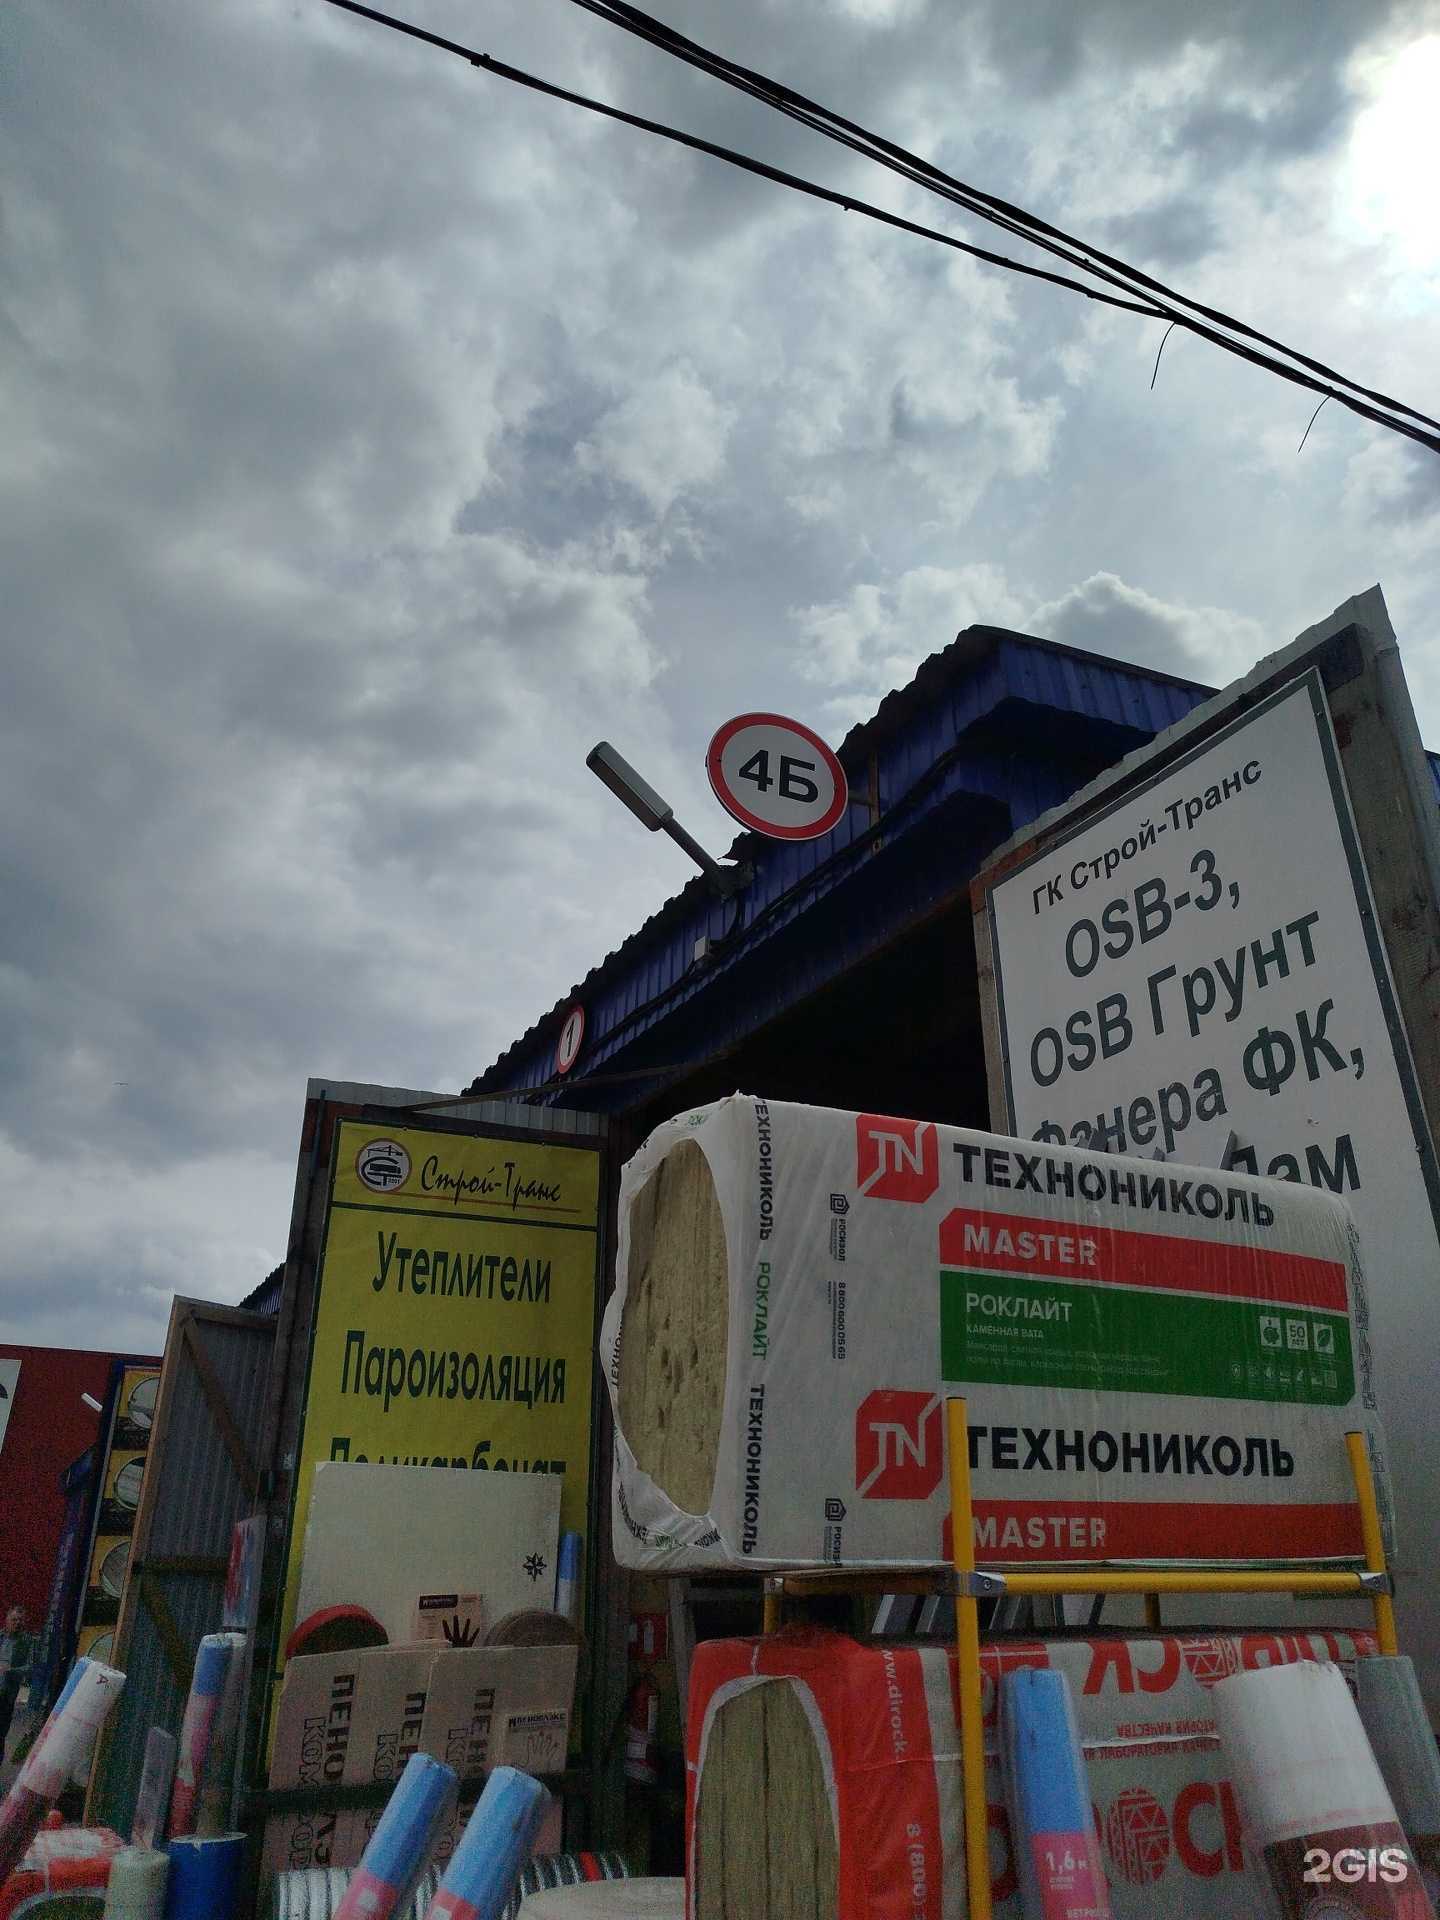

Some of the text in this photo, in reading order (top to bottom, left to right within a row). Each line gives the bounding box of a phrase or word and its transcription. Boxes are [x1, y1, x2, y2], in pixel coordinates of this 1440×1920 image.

[738, 750, 819, 803] 4Б
[1031, 758, 1263, 914] ГК Строй-Транс
[1064, 848, 1241, 979] OSB-3,
[1029, 911, 1320, 1088] OSB Грунт
[421, 1155, 561, 1211] Строй-Транс
[754, 1099, 773, 1241] ЕХНОНИКОЛЬ
[953, 1143, 1275, 1227] ТЕХНОНИКОЛЬ
[373, 1230, 552, 1303] Утеплители
[963, 1223, 1097, 1266] MASTER
[751, 1261, 772, 1360] РОКЛАЙТ
[966, 1292, 1073, 1322] РОКЛАЙТ
[1290, 1325, 1306, 1339] 50
[340, 1329, 567, 1413] Пароизоляция
[742, 1384, 766, 1554] ТЕХНОНИКОЛЬ
[967, 1426, 1295, 1477] ТЕХНОНИКОЛЬ
[972, 1515, 1106, 1549] MASTER
